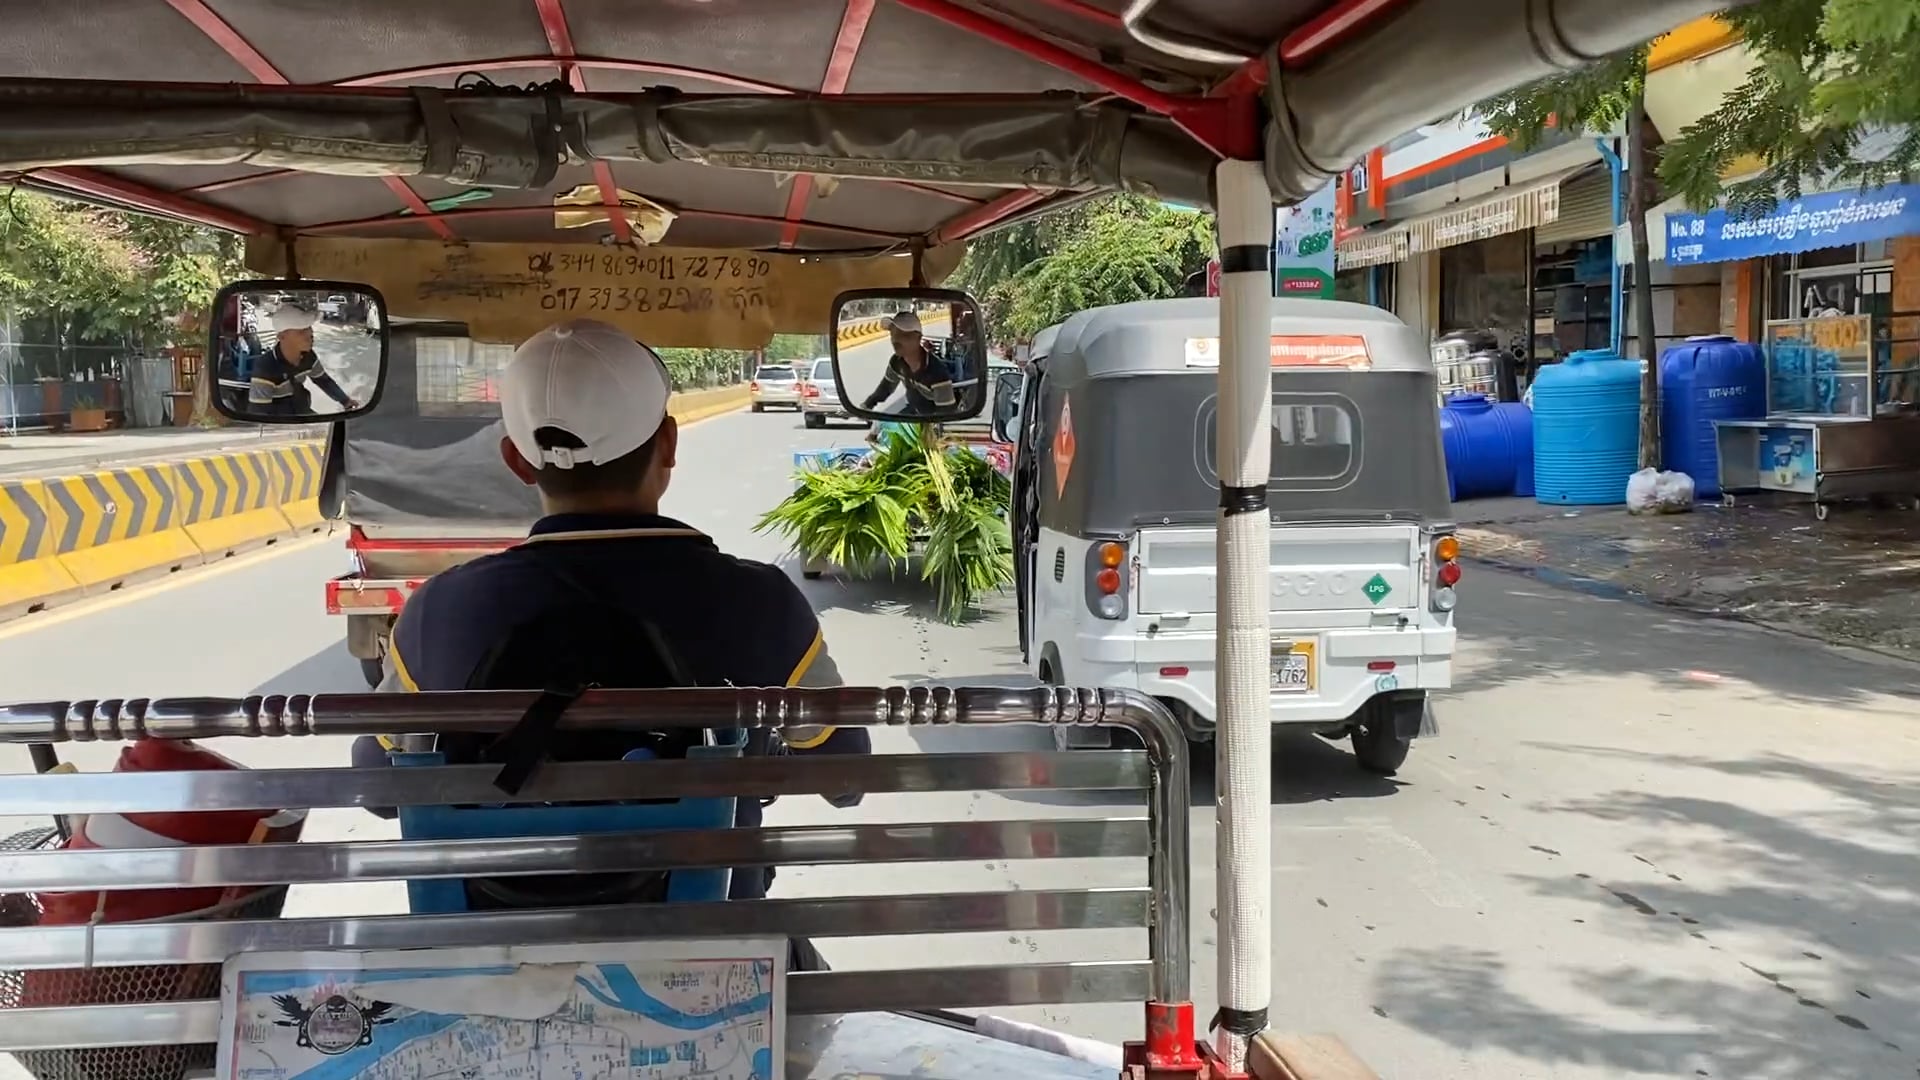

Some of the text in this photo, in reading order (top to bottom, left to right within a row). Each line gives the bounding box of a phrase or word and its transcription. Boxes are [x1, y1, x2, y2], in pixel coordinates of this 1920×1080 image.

[1670, 219, 1705, 238] No. 88
[560, 253, 595, 273] 344
[540, 287, 581, 311] 097
[1369, 584, 1385, 593] LPG
